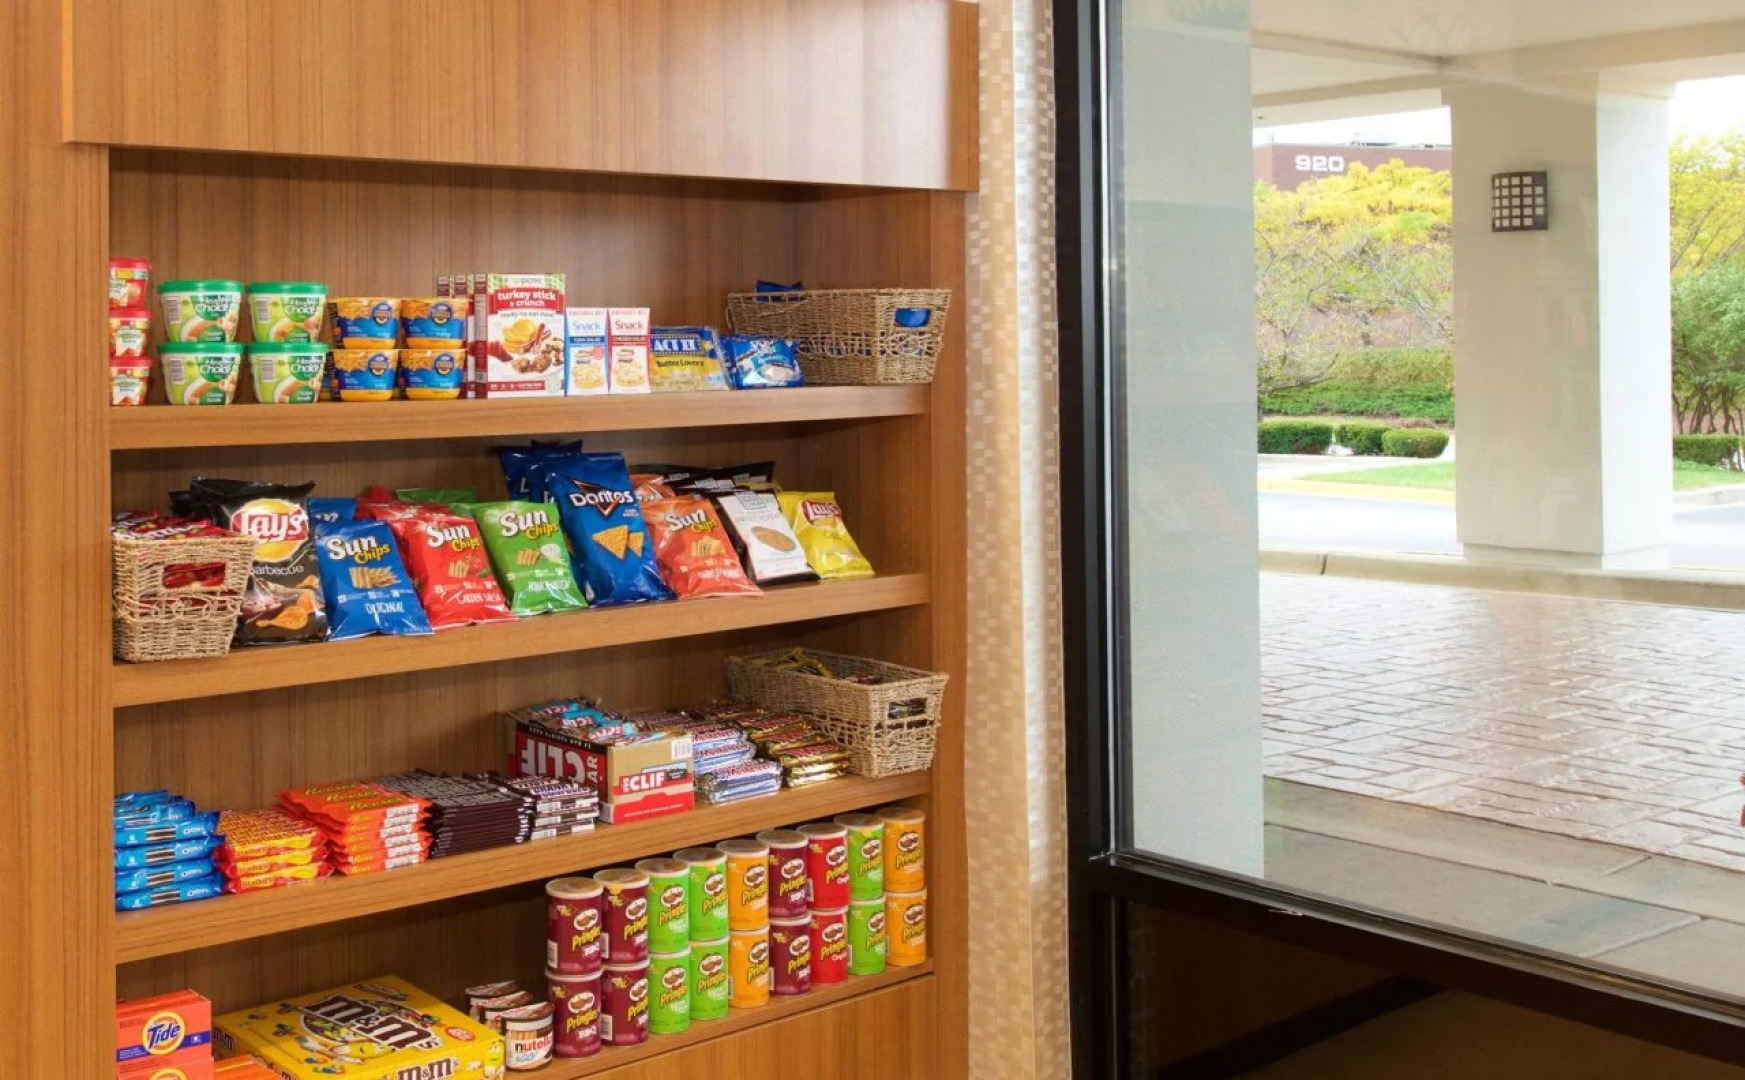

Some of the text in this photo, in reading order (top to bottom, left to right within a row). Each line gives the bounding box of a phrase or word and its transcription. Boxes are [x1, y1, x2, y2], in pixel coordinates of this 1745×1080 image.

[1295, 155, 1345, 172] 920
[498, 289, 556, 300] turkey stick
[572, 321, 601, 331] Snack
[614, 321, 643, 331] Snack
[654, 338, 698, 351] ACT II
[200, 364, 231, 374] Choice
[291, 363, 319, 373] Choice
[656, 359, 679, 368] Butter
[569, 490, 634, 507] Doritos
[500, 510, 548, 537] Sun
[664, 509, 707, 531] Sun
[427, 524, 471, 547] Sun
[525, 522, 559, 539] Chips
[325, 535, 377, 560] Sun
[354, 543, 390, 564] Chips
[521, 738, 586, 785] CLIF
[587, 756, 598, 783] AR
[629, 772, 665, 792] CLIF
[702, 891, 728, 915] Pringle
[742, 882, 768, 905] Pringle
[147, 1022, 181, 1050] Tide
